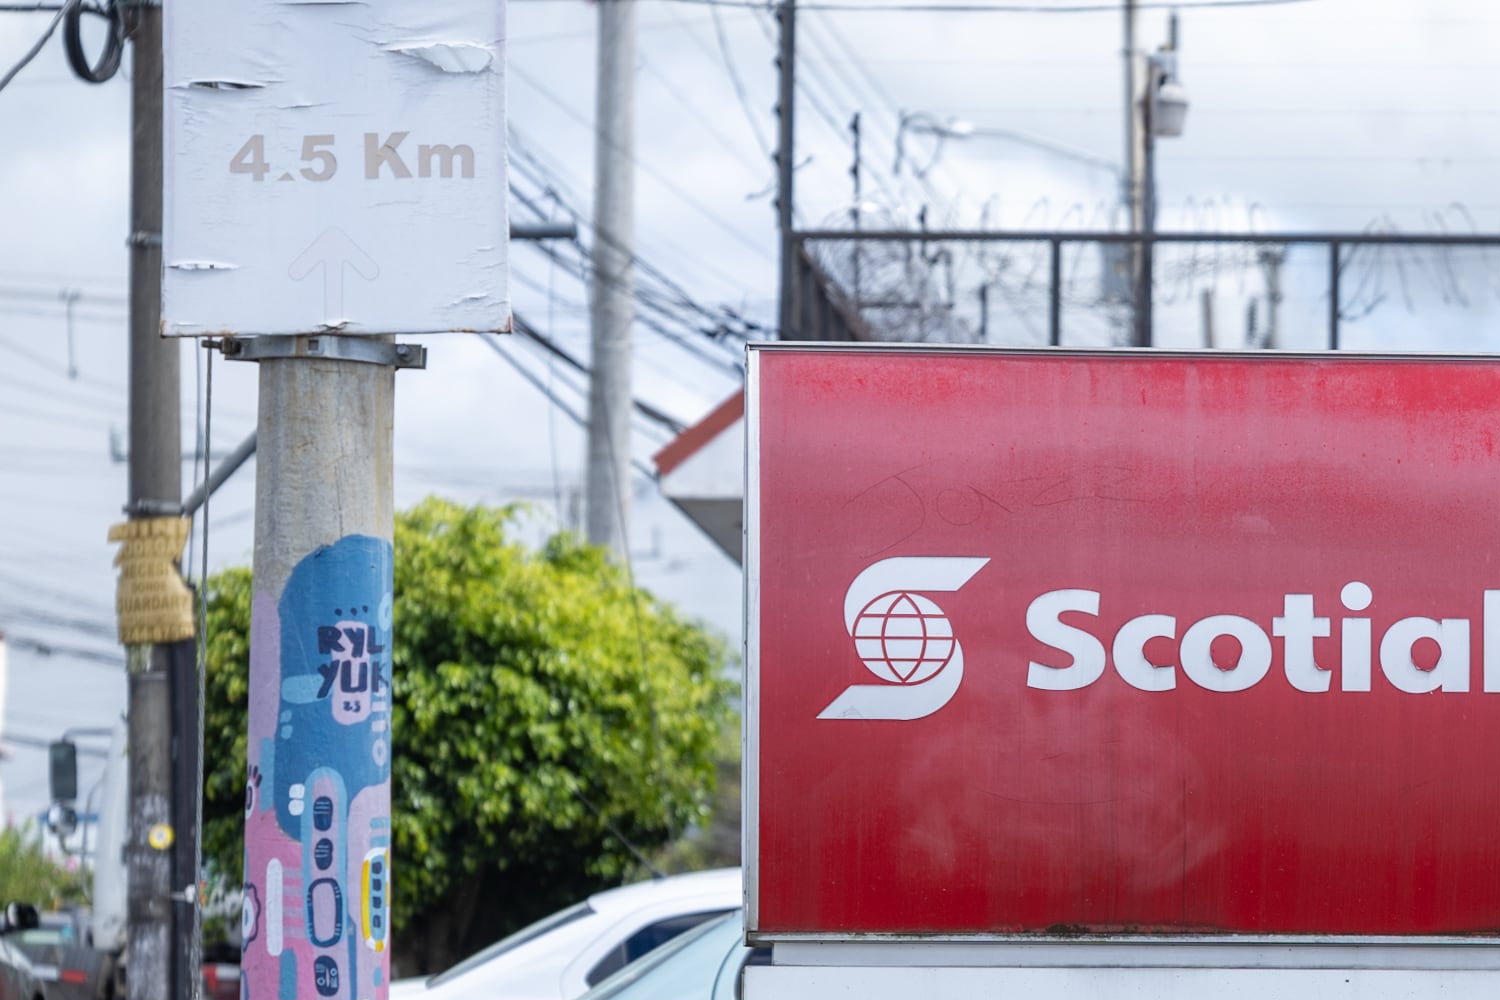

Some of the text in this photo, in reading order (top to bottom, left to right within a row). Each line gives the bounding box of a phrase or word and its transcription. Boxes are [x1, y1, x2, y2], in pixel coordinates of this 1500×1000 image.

[229, 131, 476, 182] 4.5 Km
[317, 625, 385, 658] RYL
[316, 660, 389, 699] YUK
